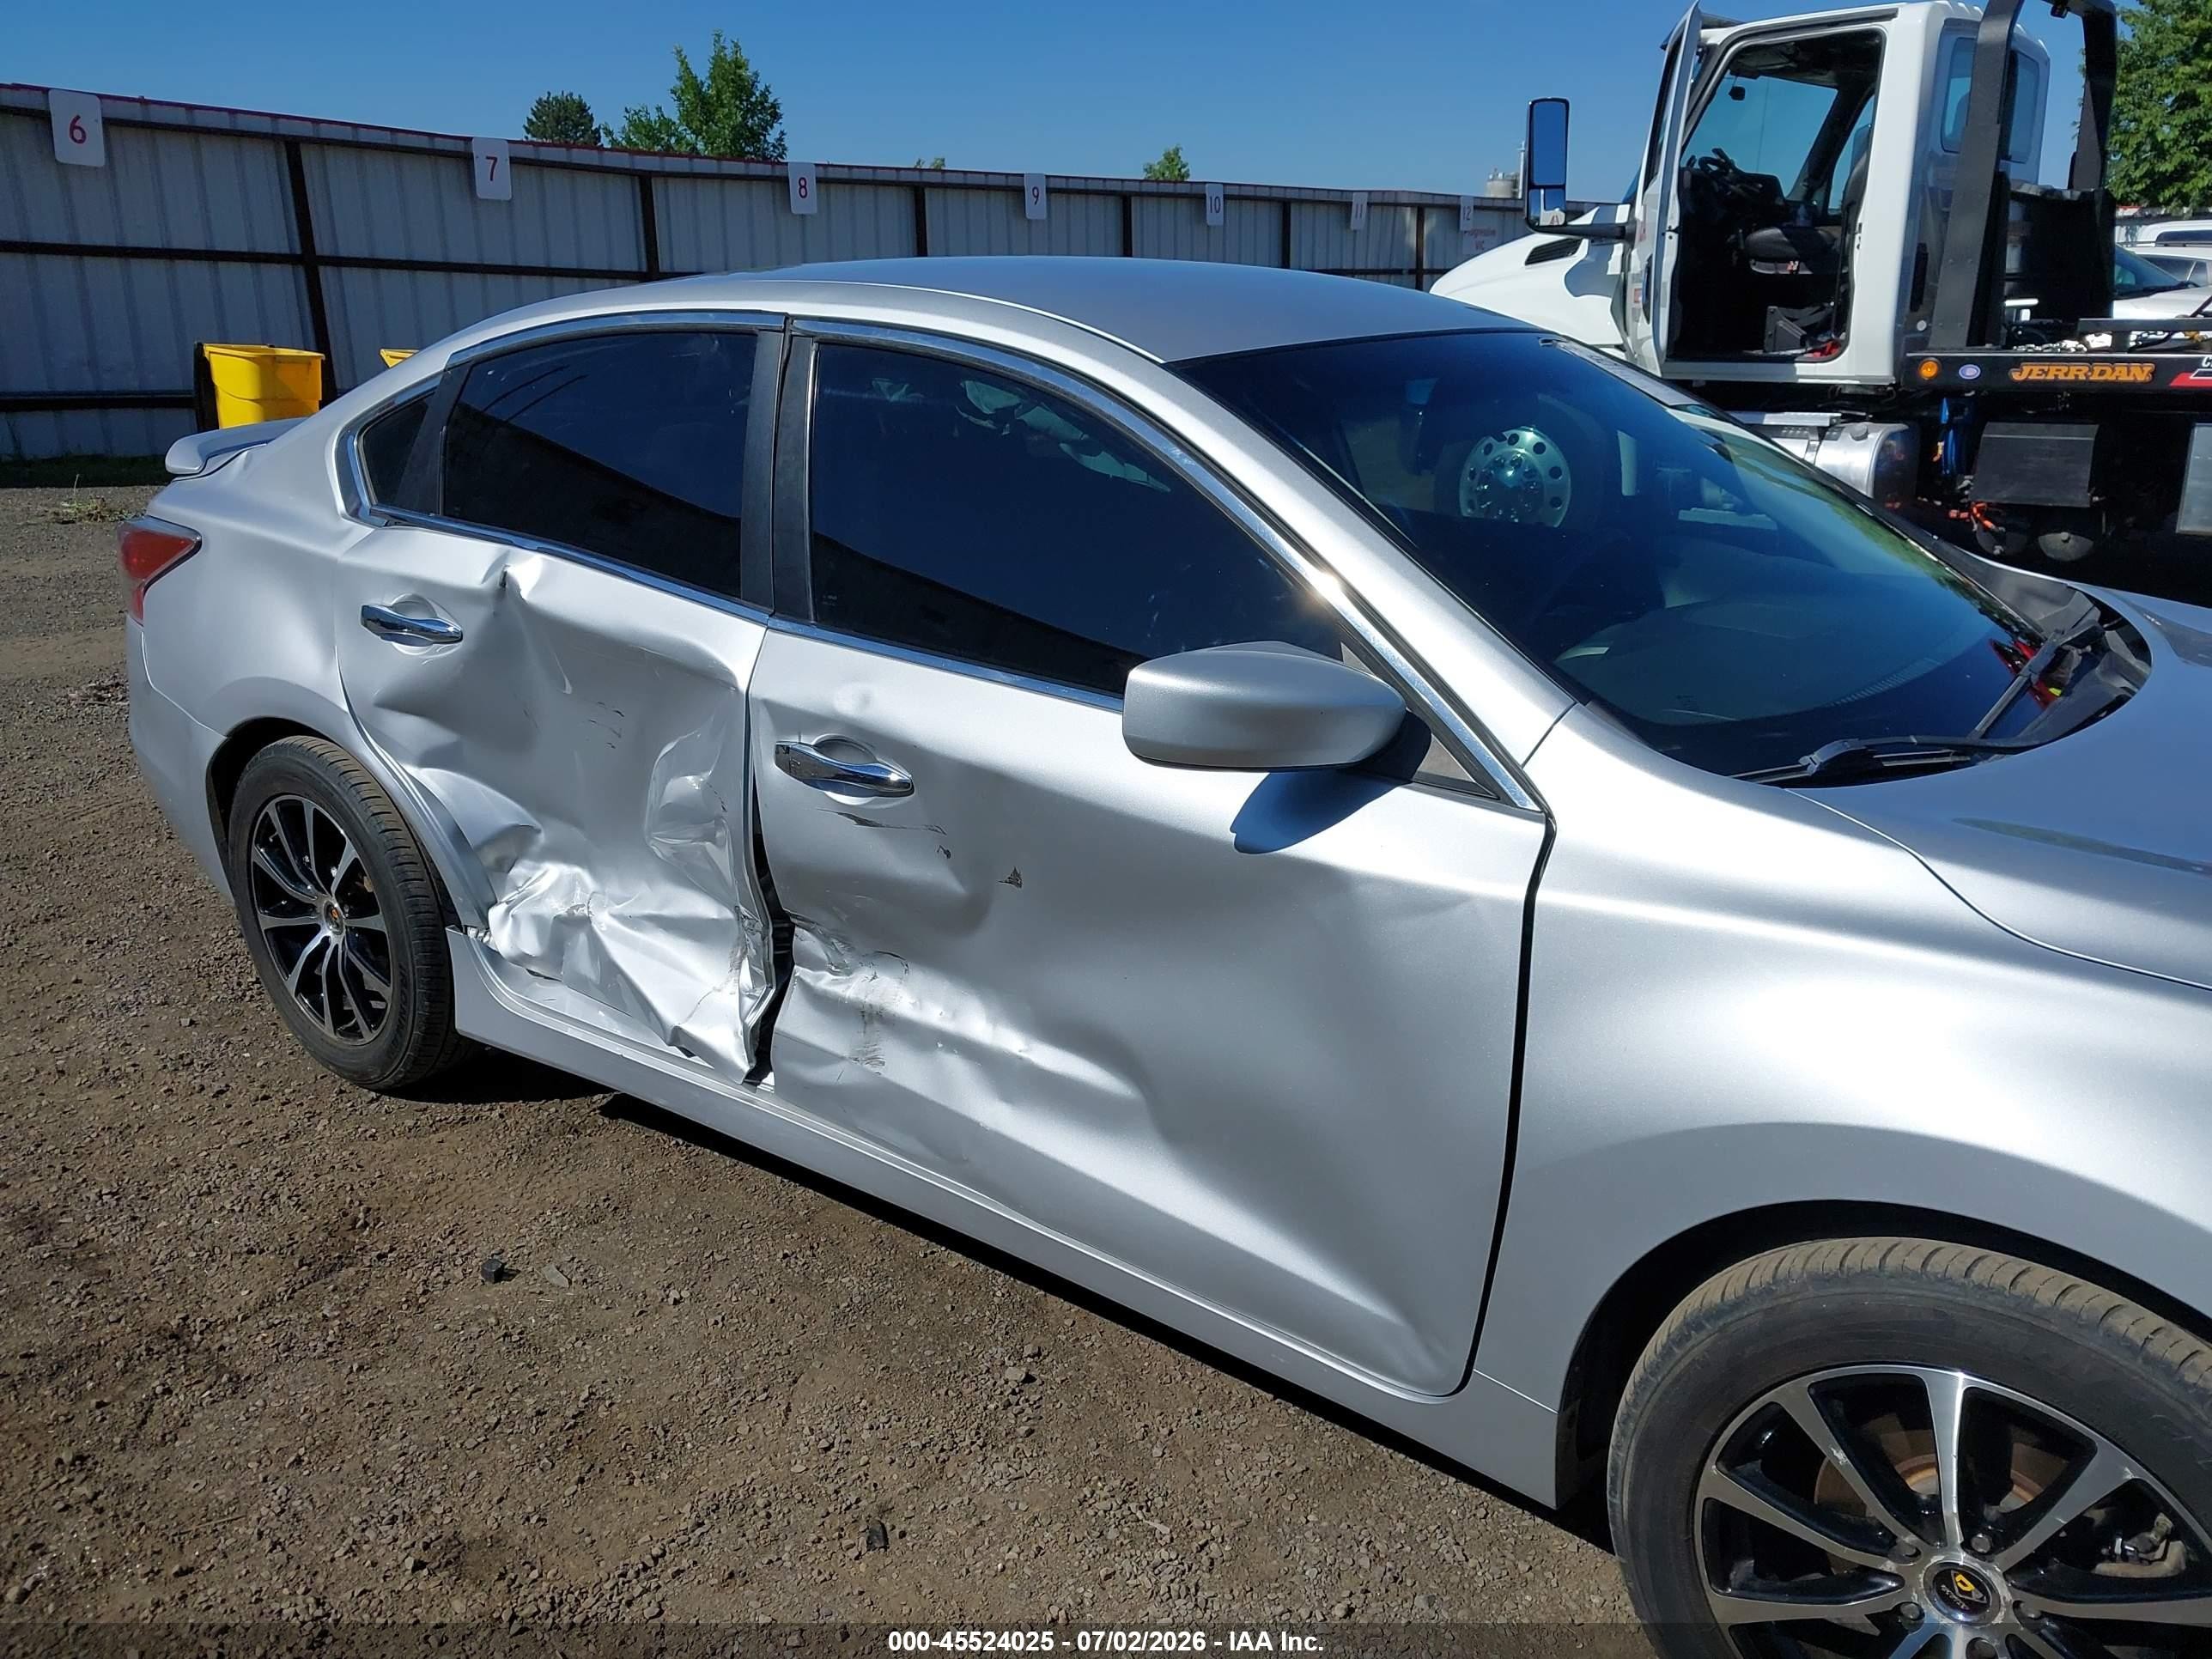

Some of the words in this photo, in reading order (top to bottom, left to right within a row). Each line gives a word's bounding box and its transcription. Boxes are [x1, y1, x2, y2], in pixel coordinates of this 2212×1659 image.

[70, 114, 87, 144] 6
[485, 155, 498, 181] 7
[799, 177, 808, 198] 8
[1032, 186, 1039, 205] 9
[1209, 196, 1220, 213] 10
[1355, 203, 1364, 218] 11
[1462, 206, 1472, 220] 12
